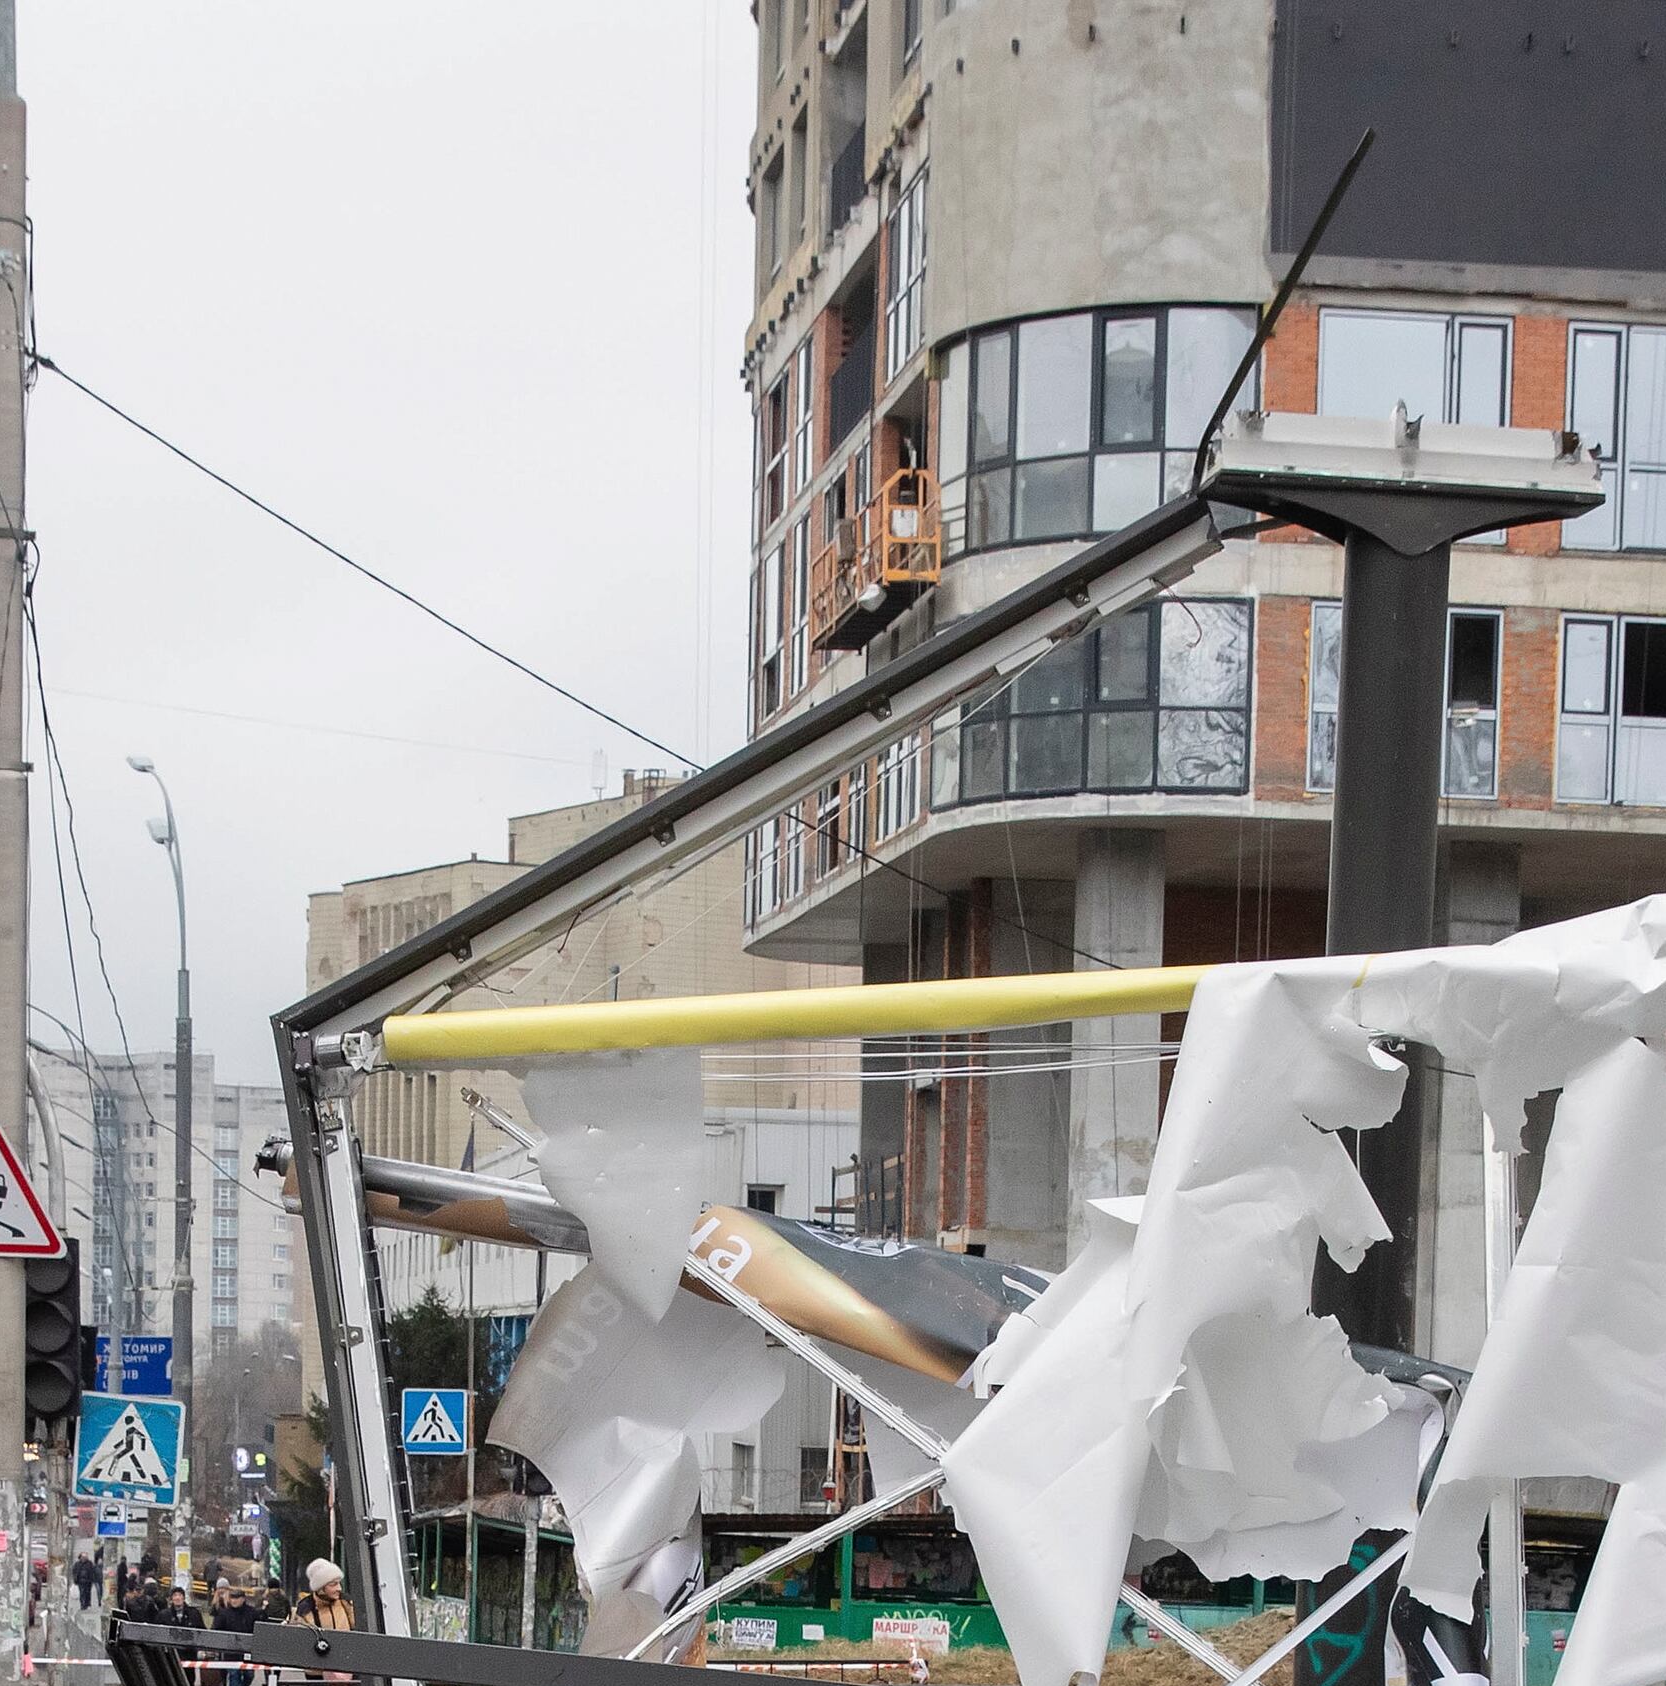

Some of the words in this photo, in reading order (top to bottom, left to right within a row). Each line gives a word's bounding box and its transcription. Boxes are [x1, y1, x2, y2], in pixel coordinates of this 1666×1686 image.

[103, 1343, 166, 1354] ЖТОМИР
[103, 1369, 139, 1379] ЛВІВ
[736, 1618, 776, 1629] КУПИМ
[875, 1620, 948, 1636] МАРШРКА
